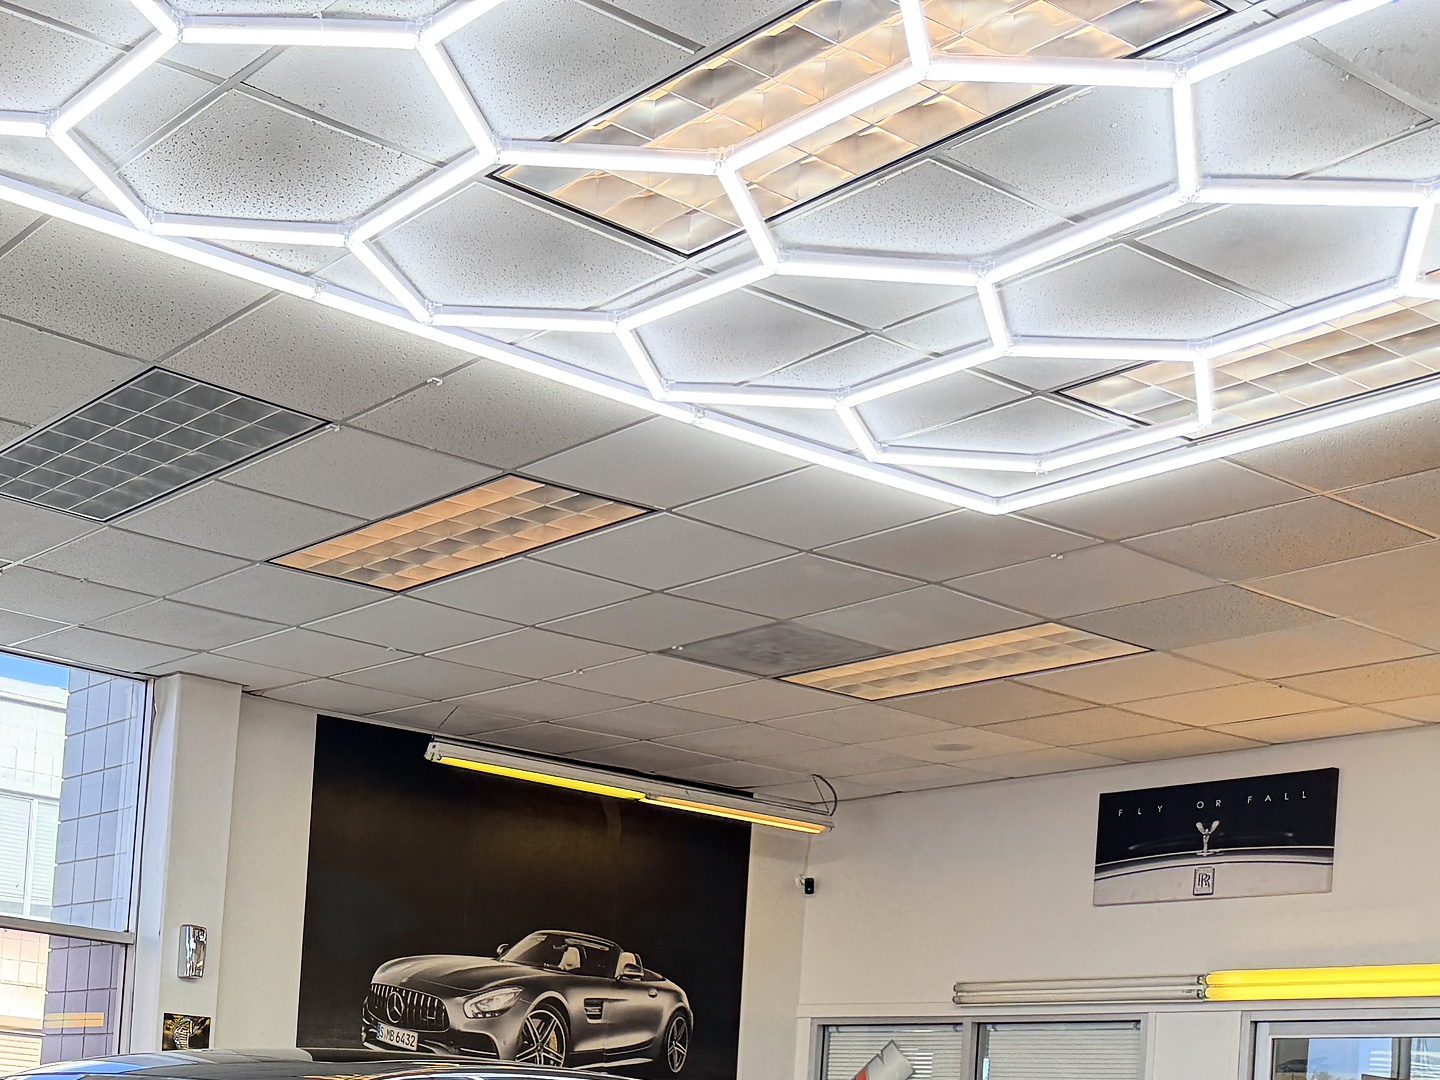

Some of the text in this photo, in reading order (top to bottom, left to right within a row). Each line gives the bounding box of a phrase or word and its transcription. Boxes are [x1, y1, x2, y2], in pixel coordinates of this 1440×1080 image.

[1118, 790, 1307, 817] FLY OR FALL
[395, 1031, 416, 1048] 6432
